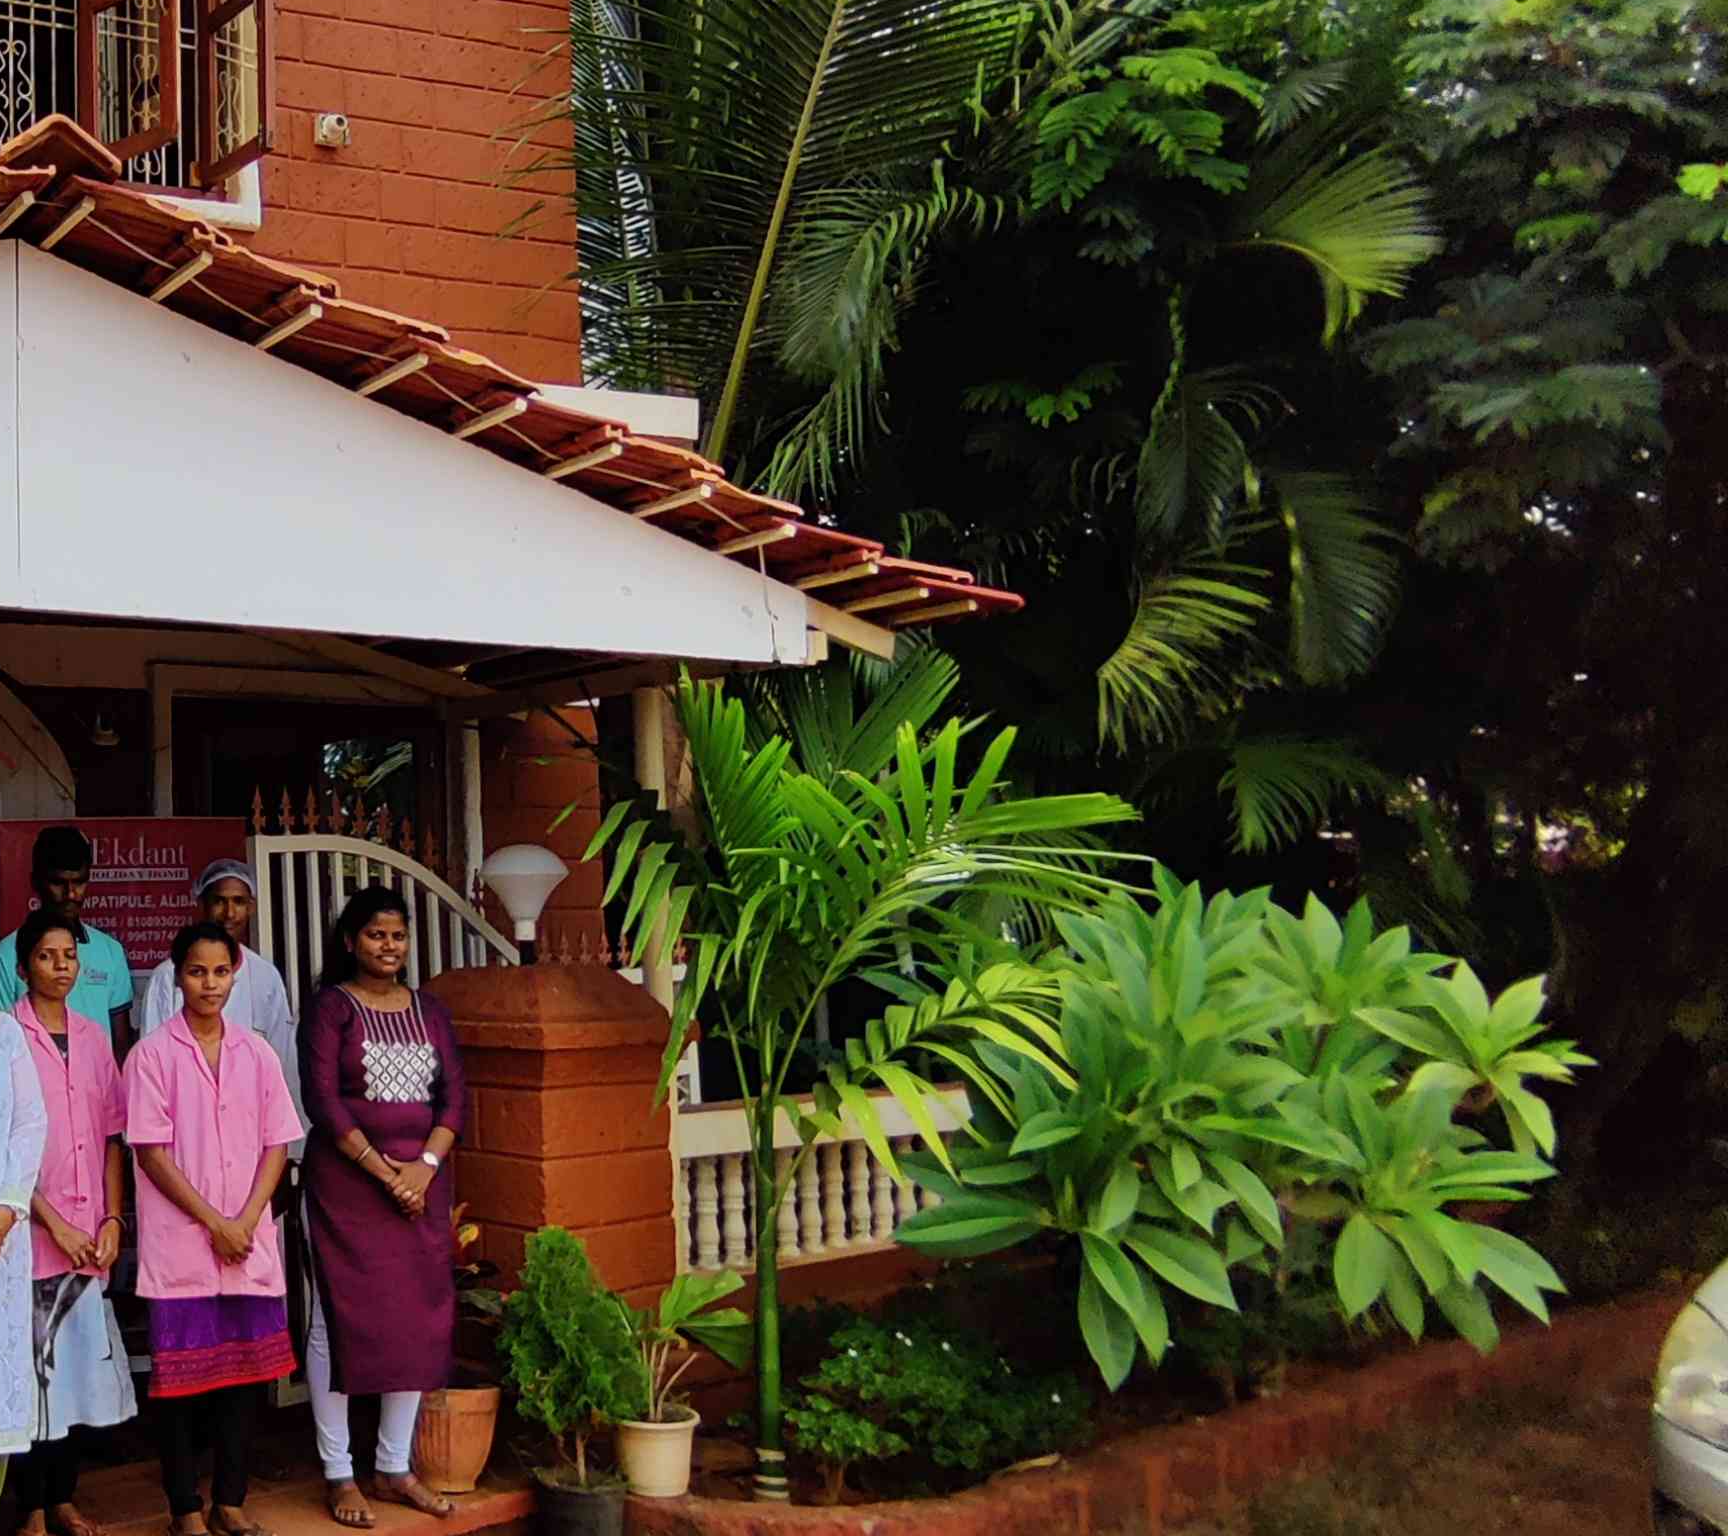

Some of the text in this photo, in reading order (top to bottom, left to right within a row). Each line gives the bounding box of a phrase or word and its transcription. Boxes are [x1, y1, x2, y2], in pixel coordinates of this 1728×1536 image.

[92, 833, 184, 865] Ekdant
[148, 869, 184, 879] HOME
[82, 893, 198, 909] NPATIPULE, ALIBA
